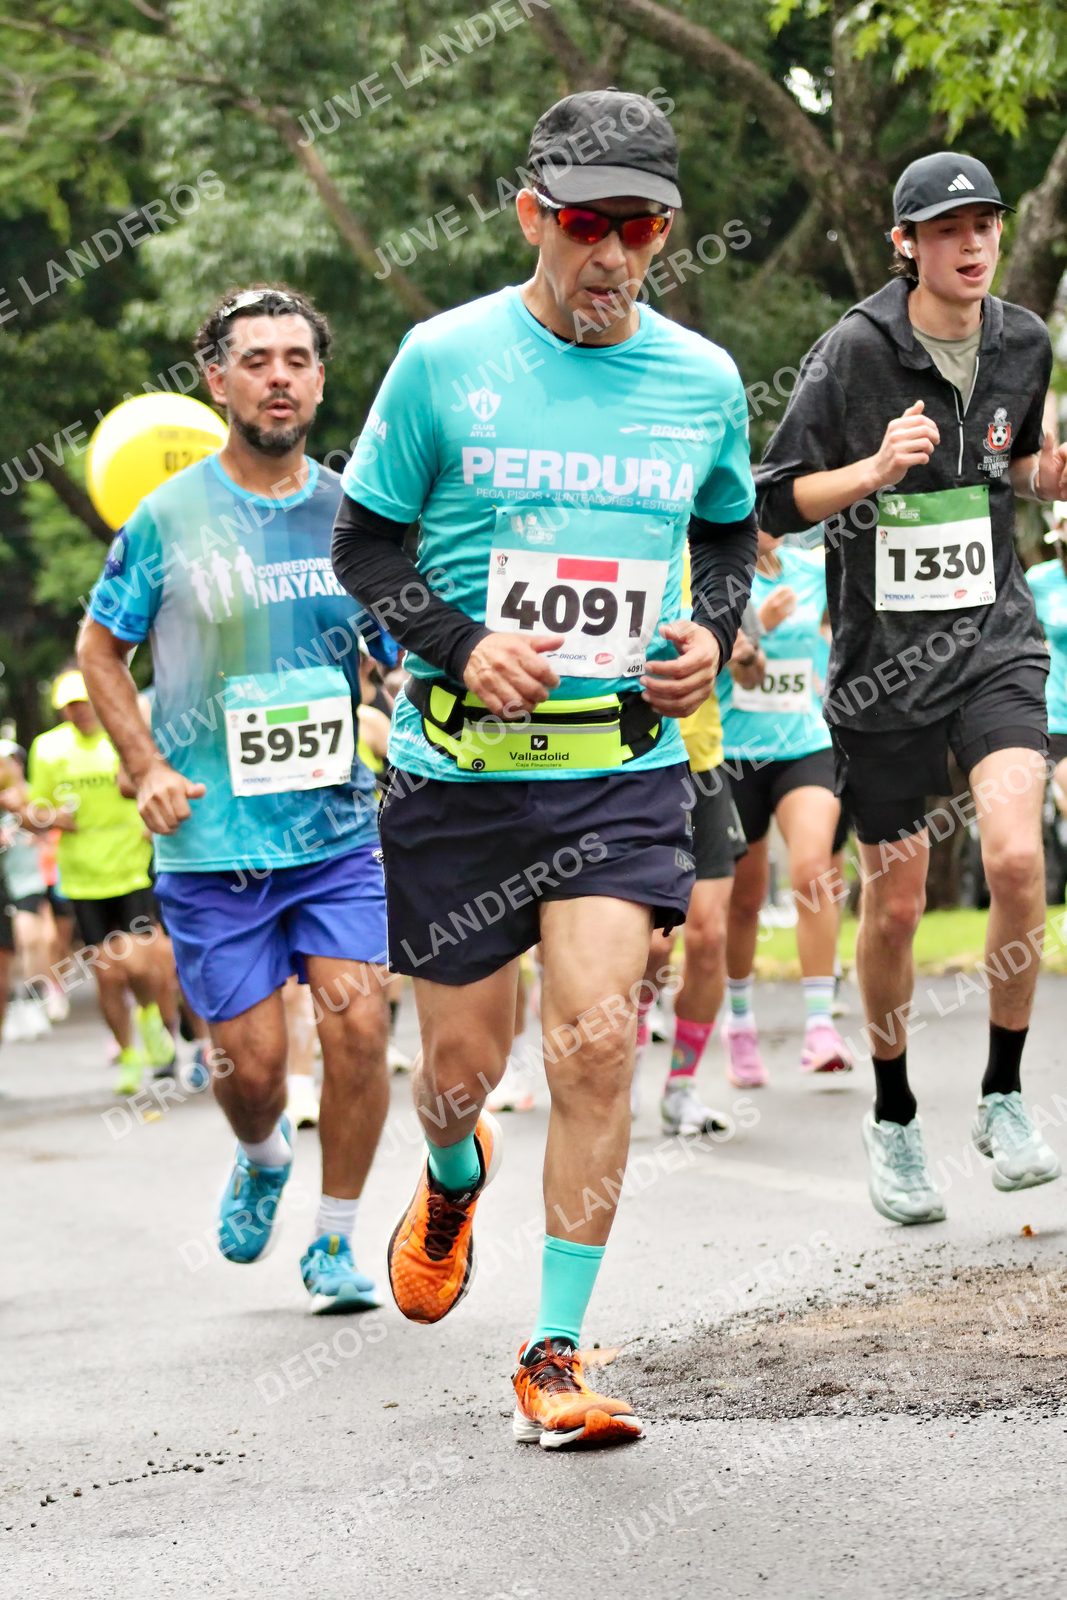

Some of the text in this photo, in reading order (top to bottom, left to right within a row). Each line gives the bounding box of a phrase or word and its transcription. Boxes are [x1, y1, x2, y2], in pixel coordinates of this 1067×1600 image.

[649, 424, 706, 440] BROOKS
[462, 446, 695, 501] PERDURA
[476, 487, 506, 498] PEGA
[507, 489, 543, 500] PISOS
[888, 541, 986, 582] 1330
[500, 580, 647, 638] 4091
[558, 653, 588, 661] BROOKS
[627, 664, 644, 674] 4091
[760, 673, 805, 694] 055
[240, 720, 343, 765] 5957
[508, 752, 570, 761] Valladolid
